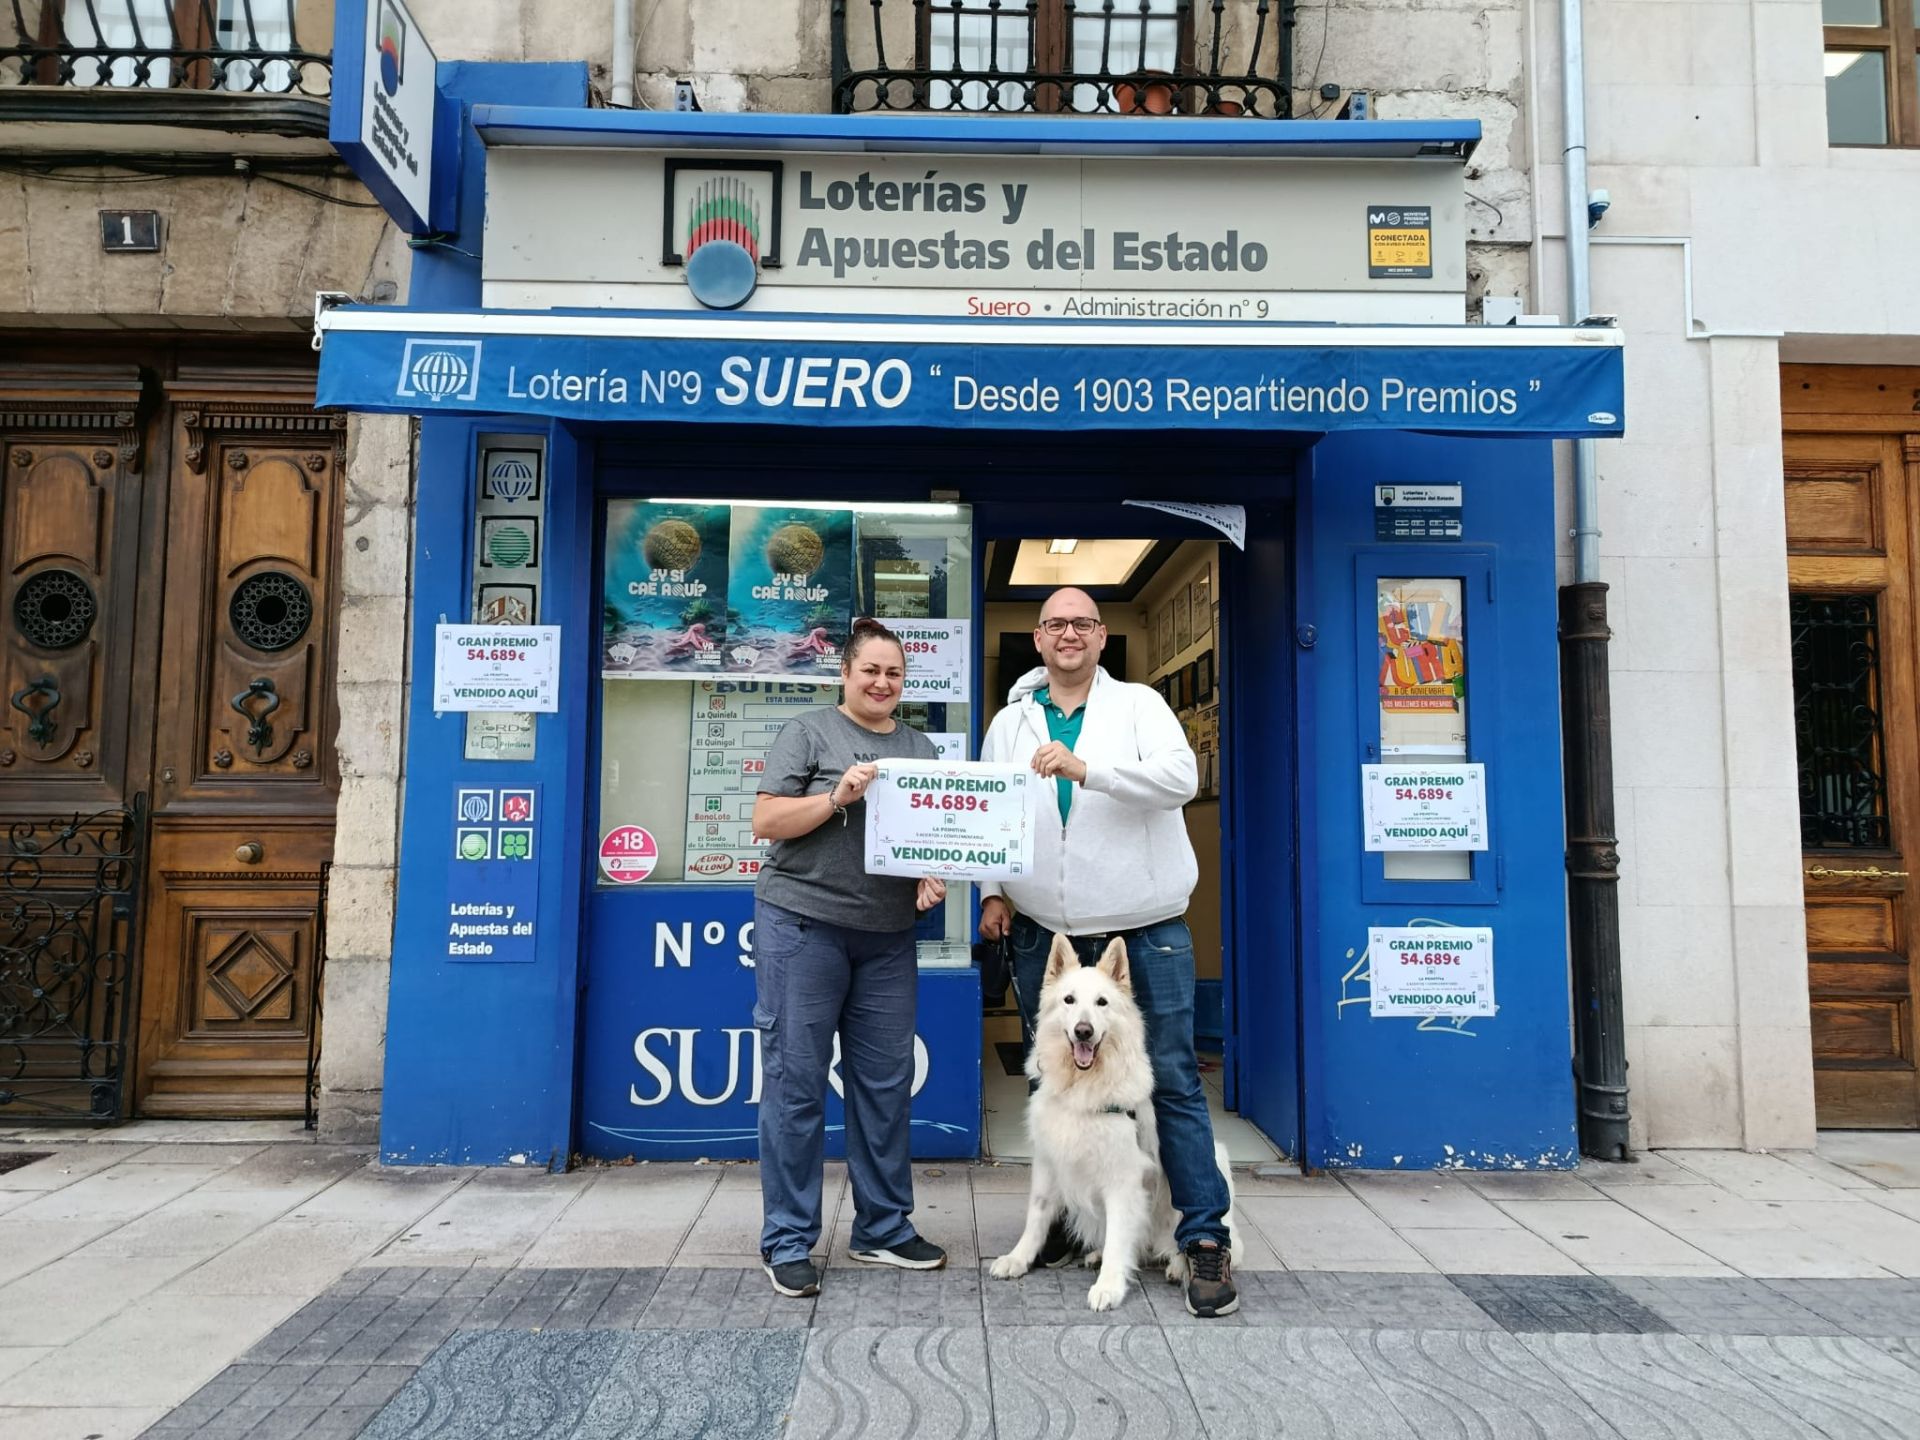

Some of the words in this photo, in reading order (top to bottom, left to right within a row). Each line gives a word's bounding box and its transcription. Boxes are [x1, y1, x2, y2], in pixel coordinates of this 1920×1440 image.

[799, 170, 986, 212] Loterías
[1001, 183, 1028, 225] y
[121, 216, 135, 244] 1
[796, 227, 1010, 278] Apuestas
[1026, 228, 1095, 271] del
[1113, 230, 1268, 272] Estado
[967, 296, 1031, 316] Suero
[1063, 296, 1222, 317] Administración
[1256, 300, 1270, 318] 9
[507, 366, 628, 404] Lotería
[715, 355, 913, 408] SUERO
[953, 376, 1059, 412] Desde
[1073, 377, 1153, 413] 1903
[1166, 375, 1370, 420] Repartiendo
[1381, 378, 1517, 415] Premios
[628, 581, 657, 596] CAE
[752, 586, 780, 600] CAE
[457, 637, 491, 647] GRAN
[493, 637, 538, 647] PREMIO
[906, 631, 949, 640] PREMIO
[922, 678, 951, 690] AQUÍ
[453, 688, 506, 698] VENDIDO
[508, 686, 538, 699] AQUÍ
[707, 711, 737, 720] Quiniela
[704, 739, 735, 748] Quinigol
[897, 776, 942, 790] GRAN
[945, 778, 1007, 793] PREMIO
[1384, 777, 1418, 787] GRAN
[1420, 776, 1464, 786] PREMIO
[1384, 828, 1438, 838] VENDIDO
[1439, 825, 1468, 839] AQUÍ
[612, 832, 644, 850] +18
[891, 846, 963, 862] VENDIDO
[966, 847, 1007, 866] AQUÍ
[450, 902, 504, 916] Loterías
[506, 905, 515, 919] y
[449, 922, 509, 938] Apuestas
[512, 922, 533, 935] del
[449, 941, 493, 955] Estado
[1389, 940, 1424, 951] GRAN
[1426, 940, 1473, 950] PREMIO
[1388, 994, 1443, 1005] VENDIDO
[1445, 991, 1476, 1006] AQUÍ
